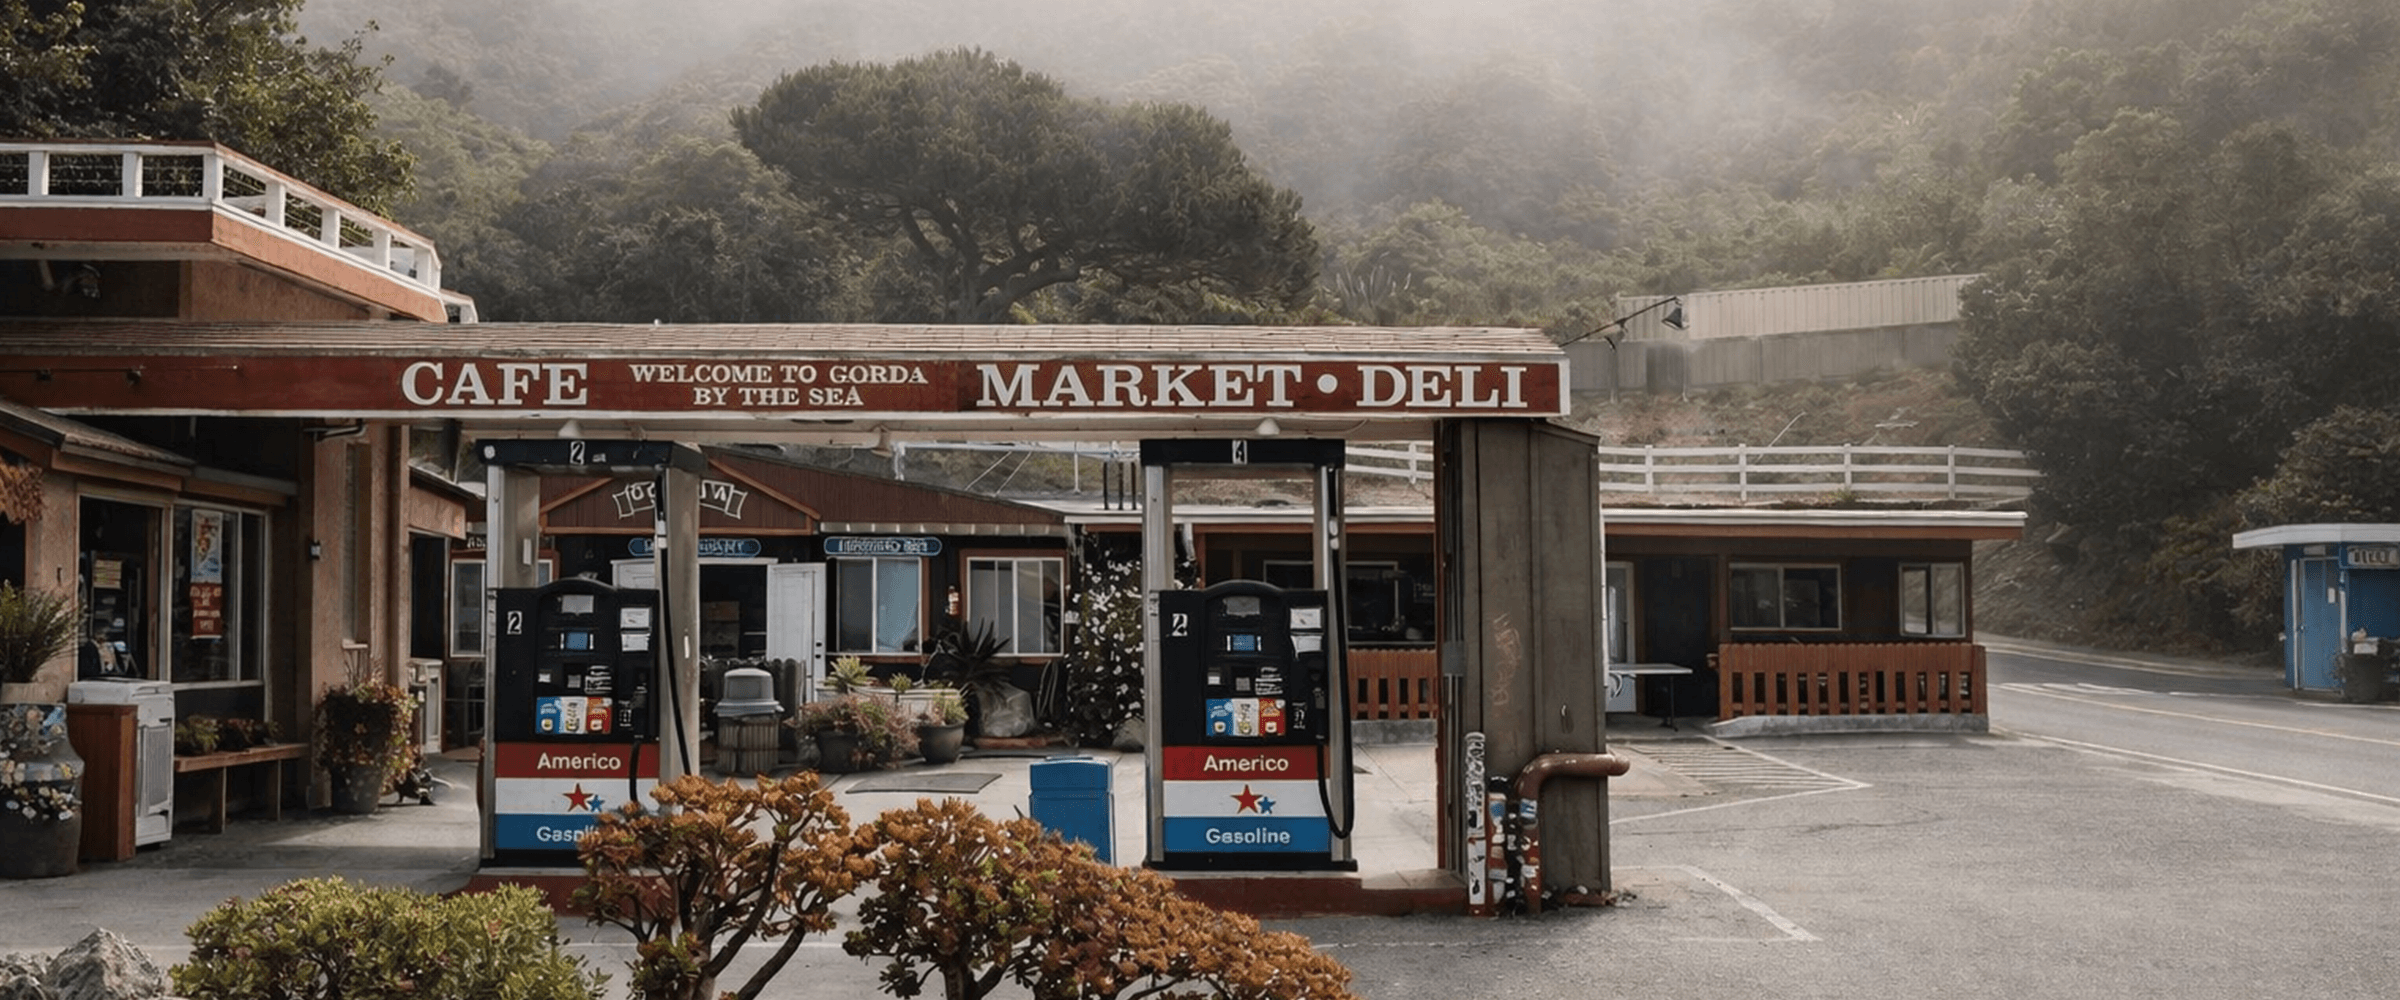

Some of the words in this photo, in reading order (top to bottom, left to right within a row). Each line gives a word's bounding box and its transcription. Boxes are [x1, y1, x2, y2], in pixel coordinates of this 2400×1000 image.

[402, 362, 587, 405] CAFE
[629, 364, 773, 383] WELCOME
[780, 364, 817, 383] TO
[829, 364, 929, 384] GORDA
[693, 387, 731, 406] BY
[738, 387, 800, 406] THE
[808, 386, 864, 406] SEA
[976, 364, 1302, 407] MARKET
[1356, 364, 1529, 408] DELI
[571, 441, 585, 464] 2
[508, 611, 522, 634] 2
[537, 752, 621, 770] Americo
[1203, 754, 1289, 772] Americo
[1205, 827, 1291, 844] Gasoline
